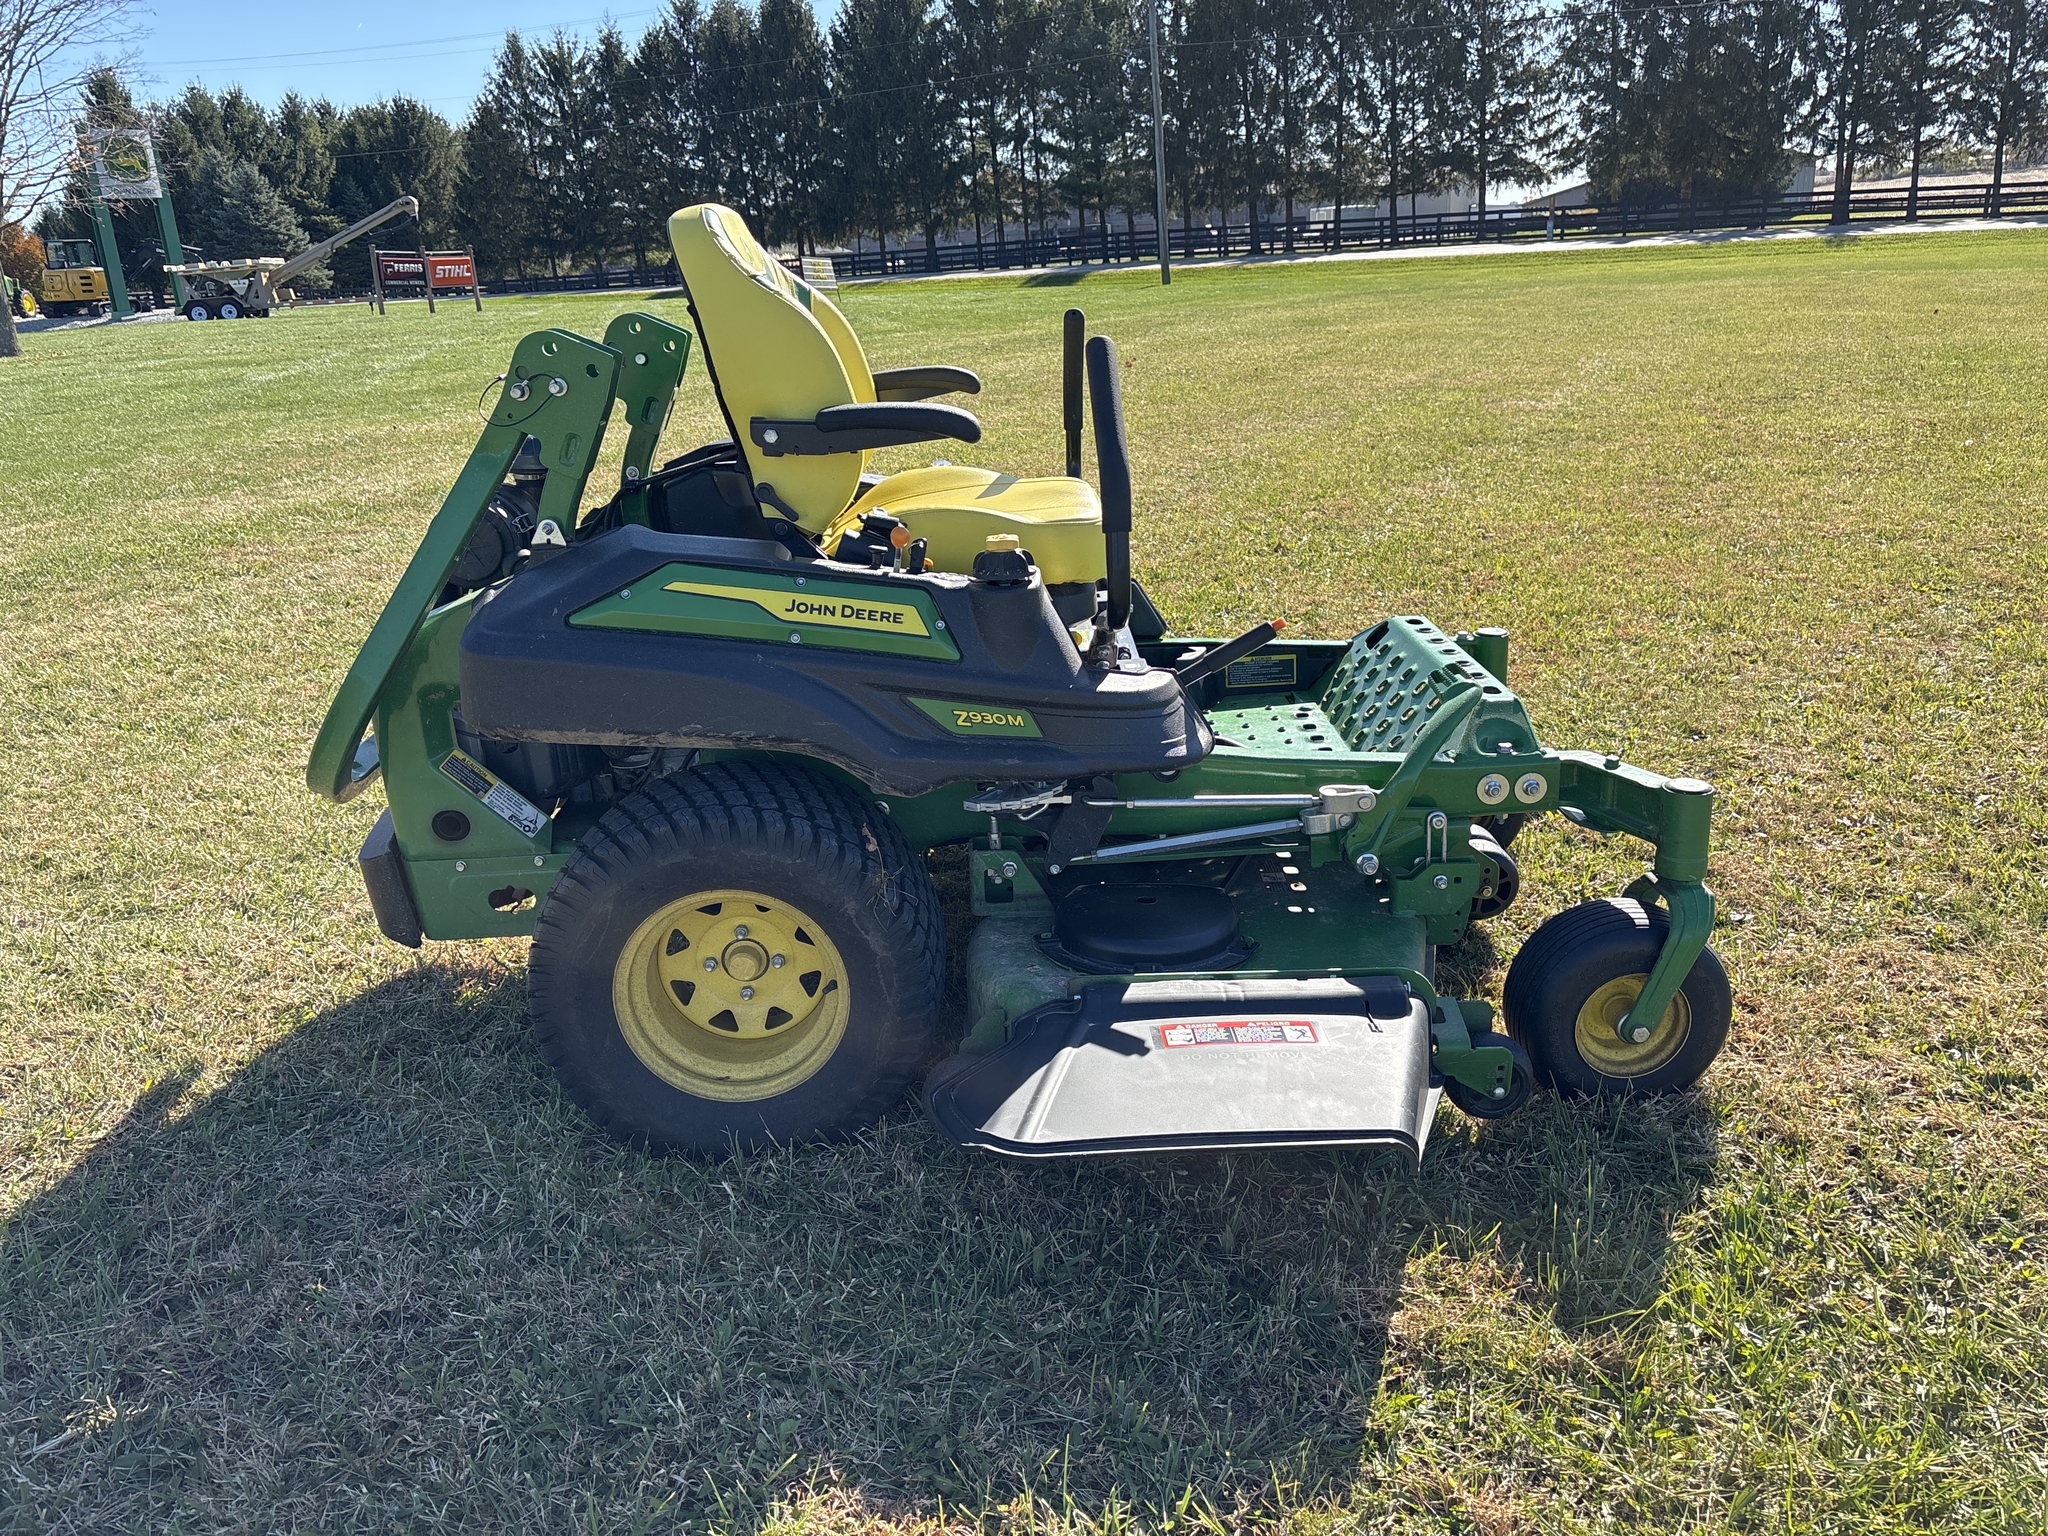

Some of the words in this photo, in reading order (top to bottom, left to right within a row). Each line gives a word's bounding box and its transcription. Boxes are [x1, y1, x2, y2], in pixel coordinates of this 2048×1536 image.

[393, 263, 423, 272] FERRIS
[435, 265, 471, 278] STIHL
[785, 599, 836, 617] JOHN
[841, 604, 904, 625] DEERE
[953, 709, 1026, 728] Z930M
[465, 759, 488, 778] CAUTION
[1180, 1053, 1202, 1062] DO
[1208, 1052, 1238, 1060] NOT
[1245, 1051, 1309, 1060] REMOVE
